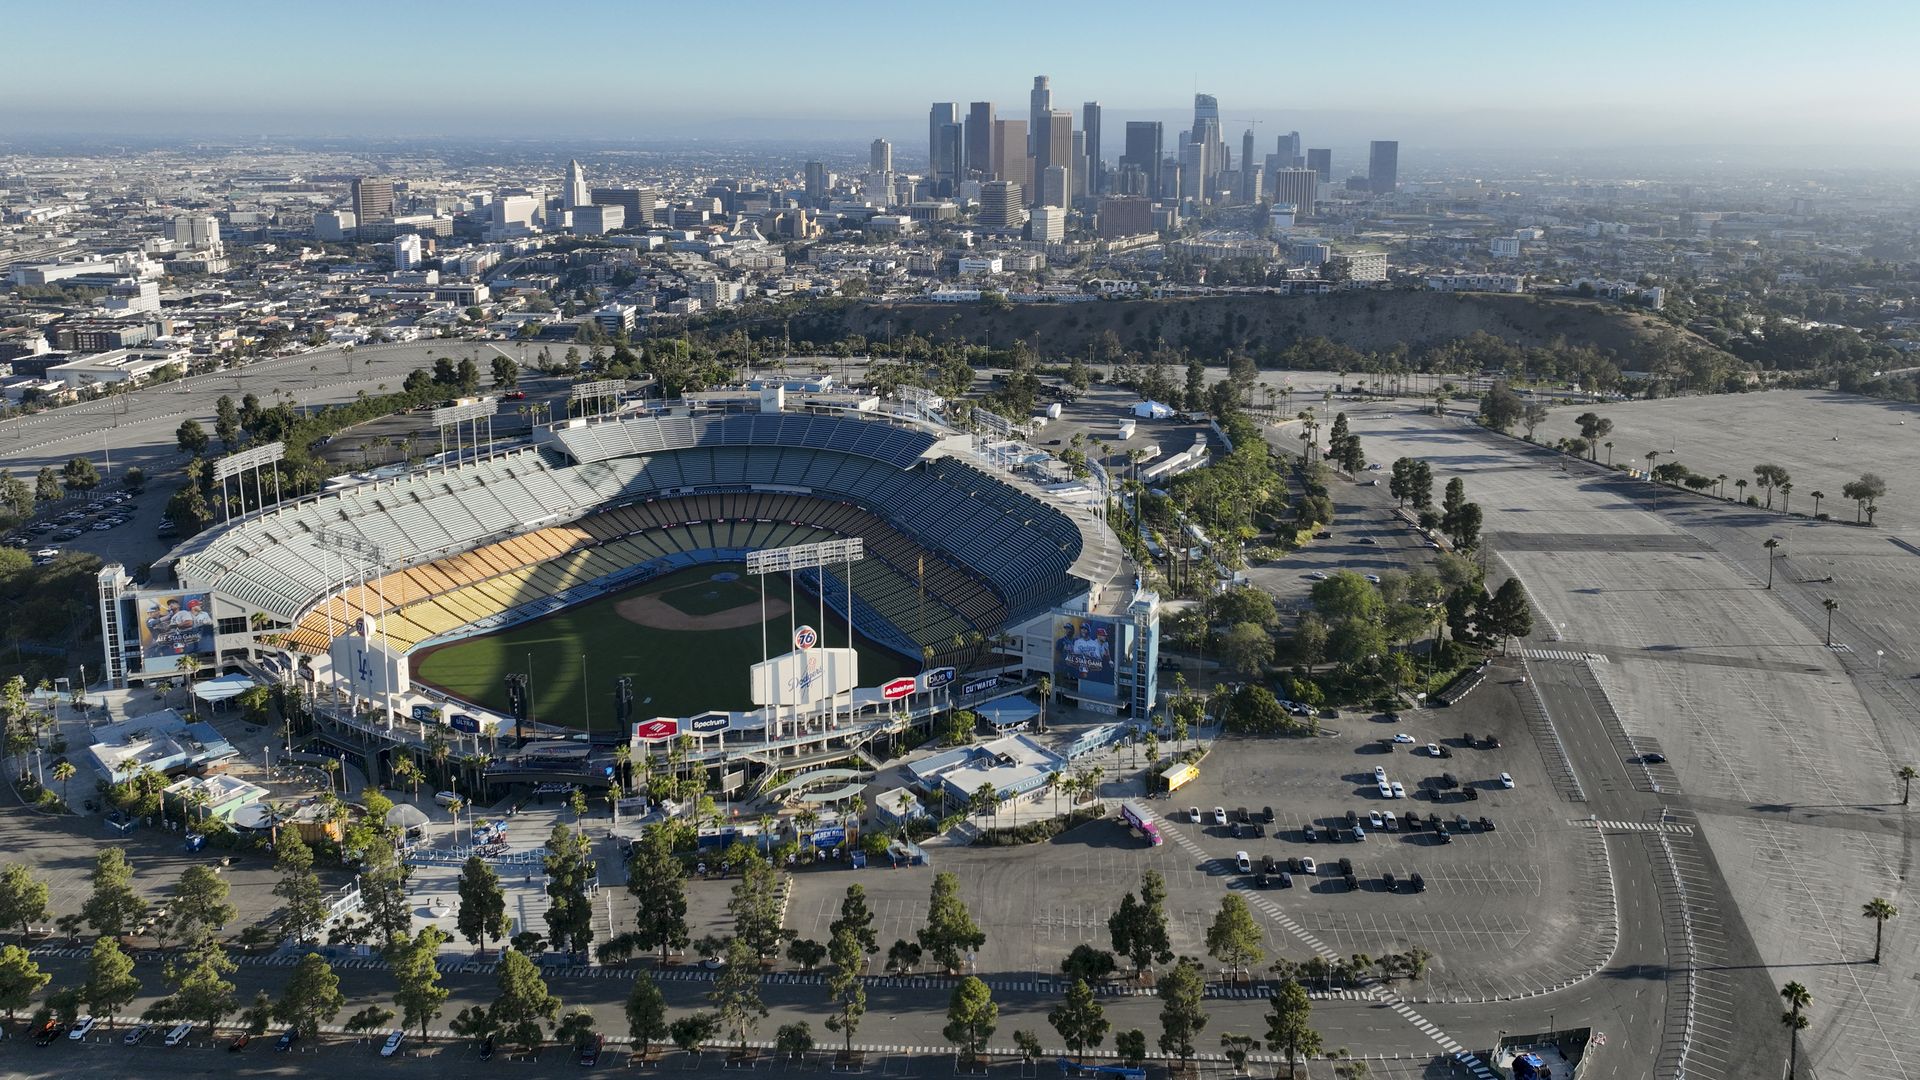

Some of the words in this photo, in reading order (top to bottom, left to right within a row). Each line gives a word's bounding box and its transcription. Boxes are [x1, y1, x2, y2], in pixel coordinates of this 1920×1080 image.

[800, 632, 813, 644] 76
[929, 673, 946, 684] blue
[455, 719, 475, 728] ULTRA
[693, 719, 725, 729] Spectrum
